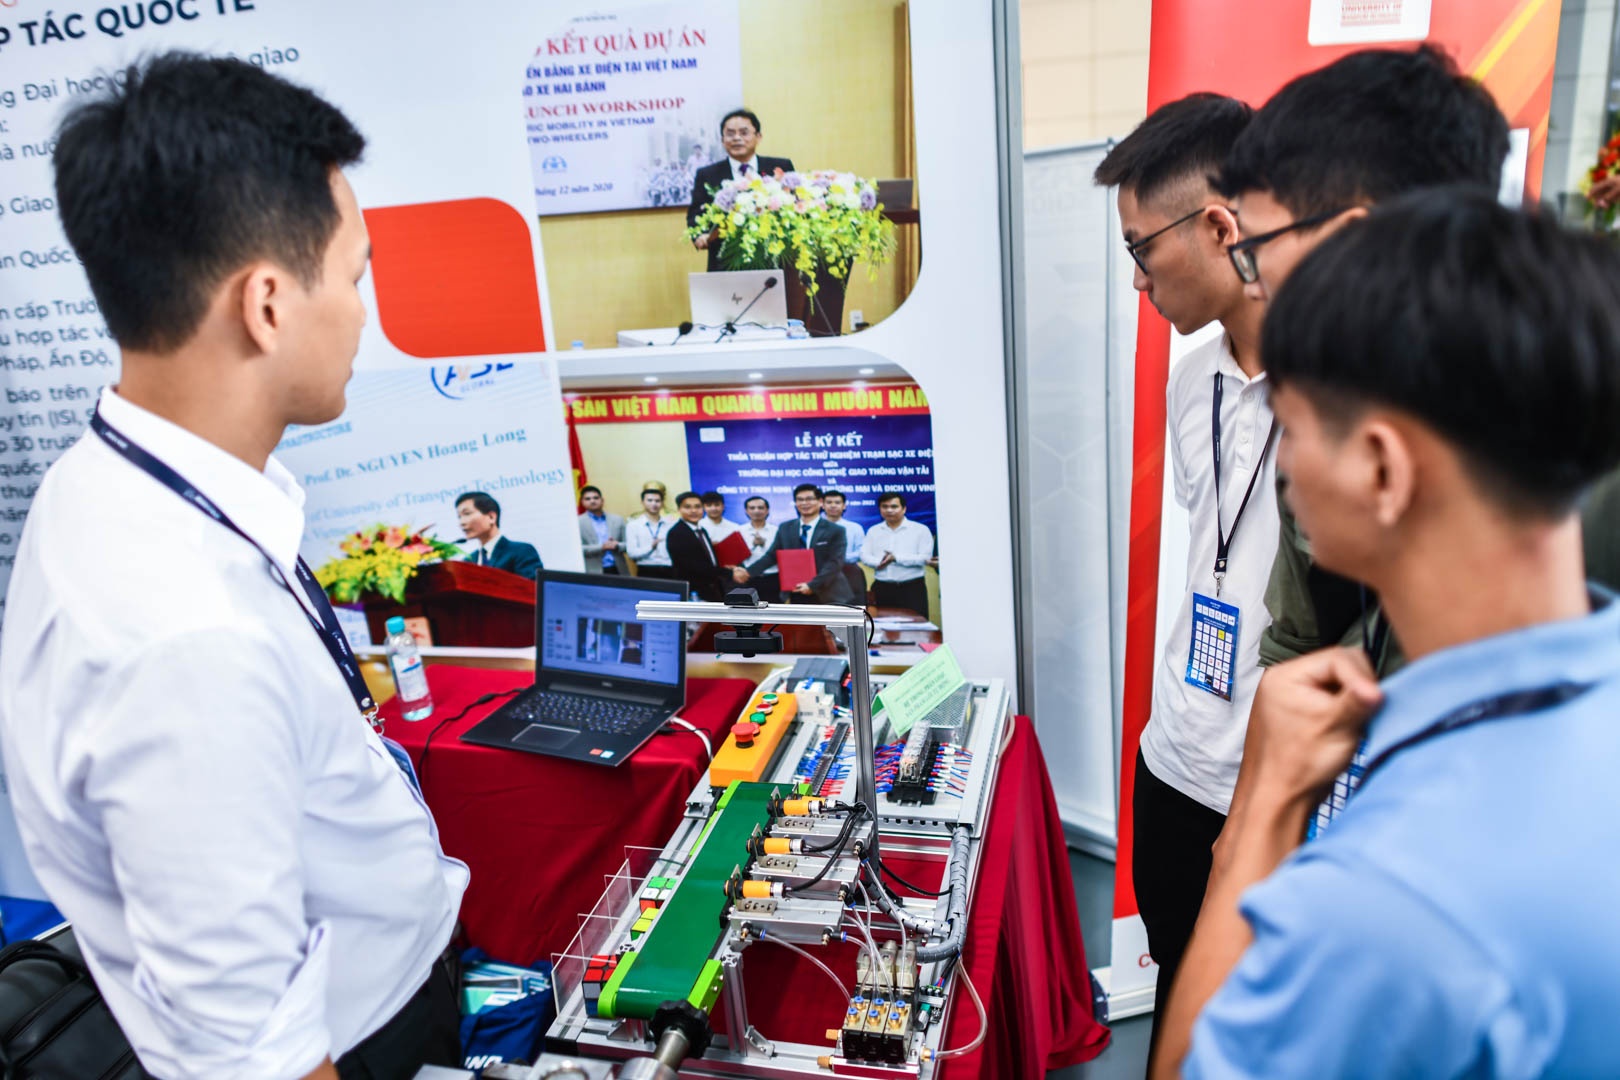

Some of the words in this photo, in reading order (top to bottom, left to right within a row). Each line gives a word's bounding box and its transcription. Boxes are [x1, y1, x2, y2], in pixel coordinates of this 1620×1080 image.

[18, 10, 86, 46] TÁC
[546, 28, 589, 57] KẾT
[593, 27, 639, 57] QUẢ
[643, 28, 673, 53] DỰ
[679, 24, 707, 48] ÁN
[250, 47, 300, 67] giao
[671, 57, 698, 70] NAM
[23, 79, 58, 102] Đại
[525, 103, 579, 119] UNCH
[582, 96, 686, 115] WORKSHOP
[610, 116, 655, 127] VIETNAM
[10, 196, 54, 214] Giao
[20, 245, 72, 269] Quốc
[14, 300, 49, 321] cấp
[52, 298, 97, 315] Trườ
[15, 329, 54, 346] hợp
[58, 325, 89, 342] tác
[49, 347, 75, 367] Ấn
[6, 387, 42, 403] báo
[49, 384, 90, 401] trên
[572, 396, 608, 417] SẢN
[611, 396, 650, 419] VIỆT
[655, 396, 698, 416] NAM
[702, 393, 766, 416] QUANG
[769, 392, 818, 413] VINH
[823, 387, 883, 411] MUÔN
[10, 436, 34, 452] 30
[794, 431, 812, 448] LỄ
[836, 431, 863, 447] KẾT
[357, 449, 423, 473] NGUYEN
[427, 439, 478, 459] Hoang
[482, 428, 527, 447] Long
[917, 448, 933, 458] ĐIỆ
[472, 467, 565, 493] Technology
